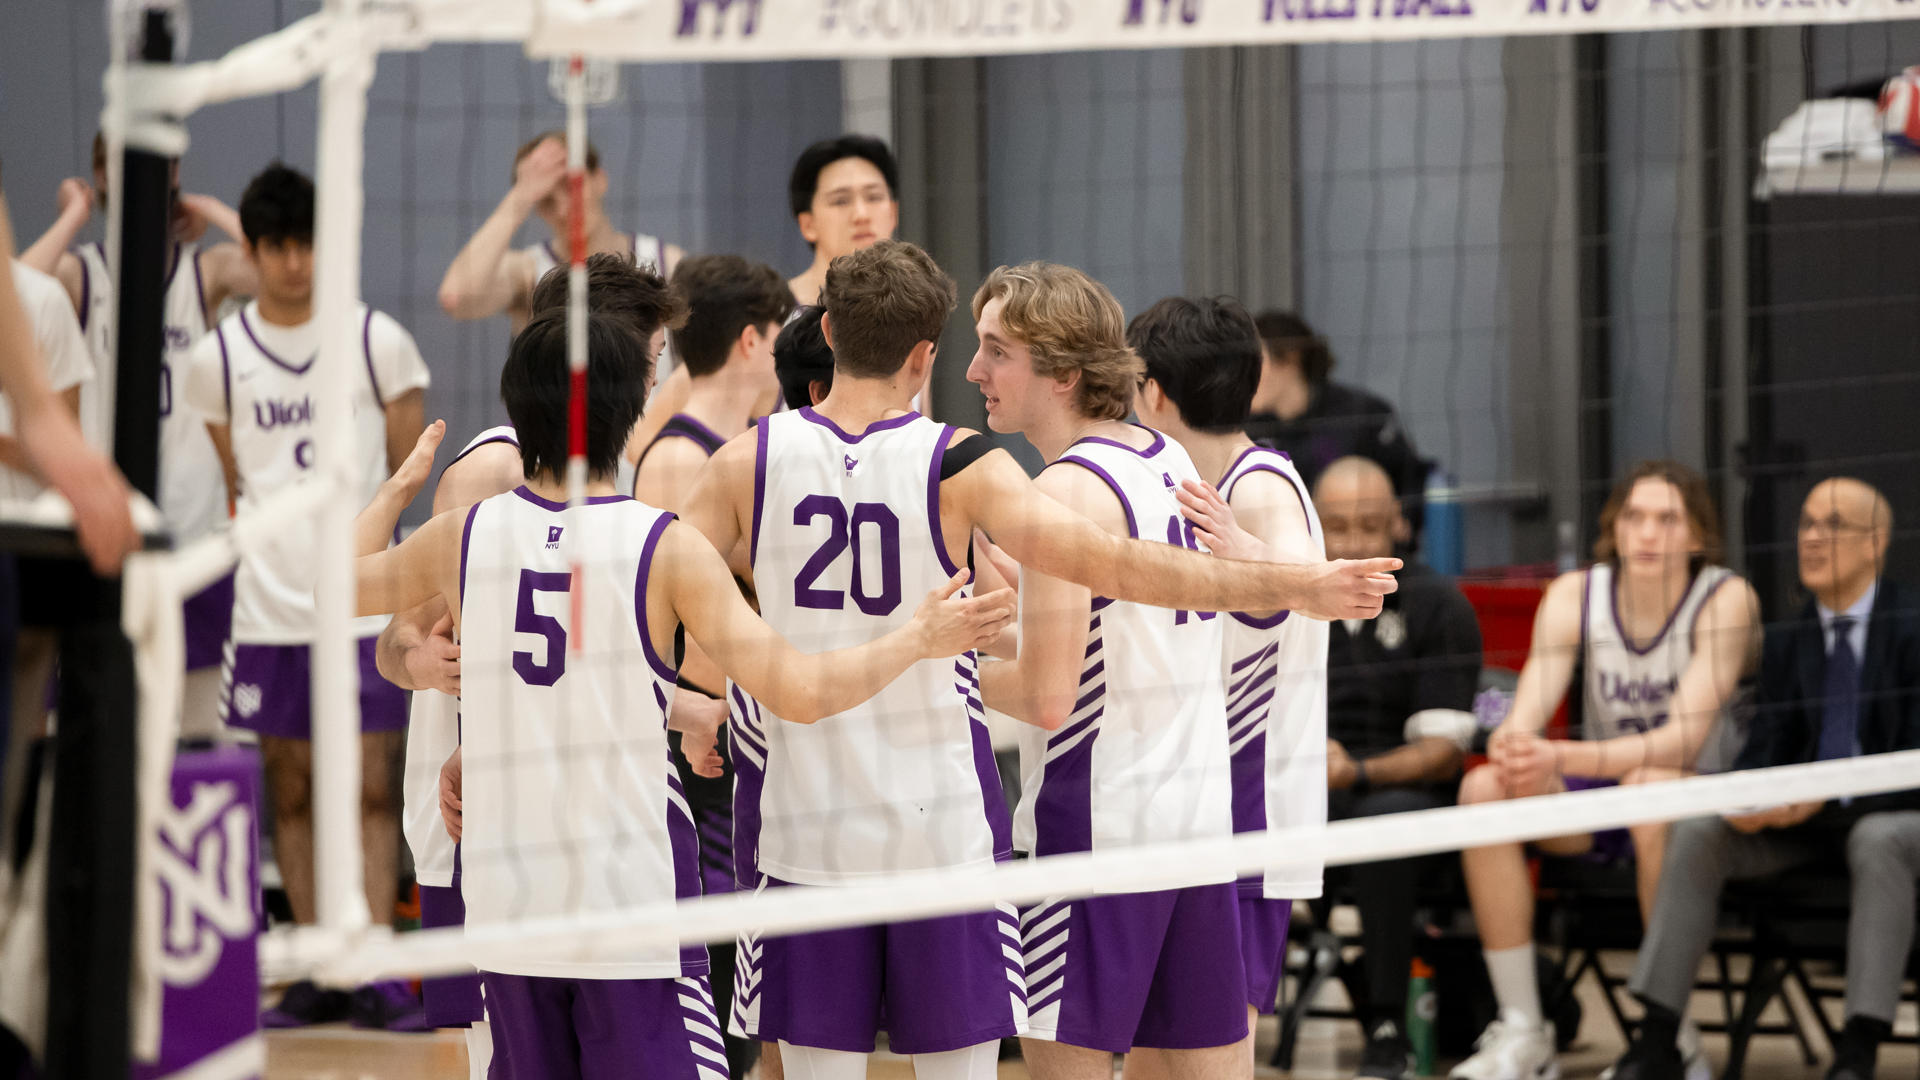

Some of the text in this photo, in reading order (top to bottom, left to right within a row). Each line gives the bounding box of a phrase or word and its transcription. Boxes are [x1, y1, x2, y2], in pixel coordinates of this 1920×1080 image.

[544, 542, 560, 550] NYU
[794, 494, 902, 617] 20
[512, 568, 573, 687] 5
